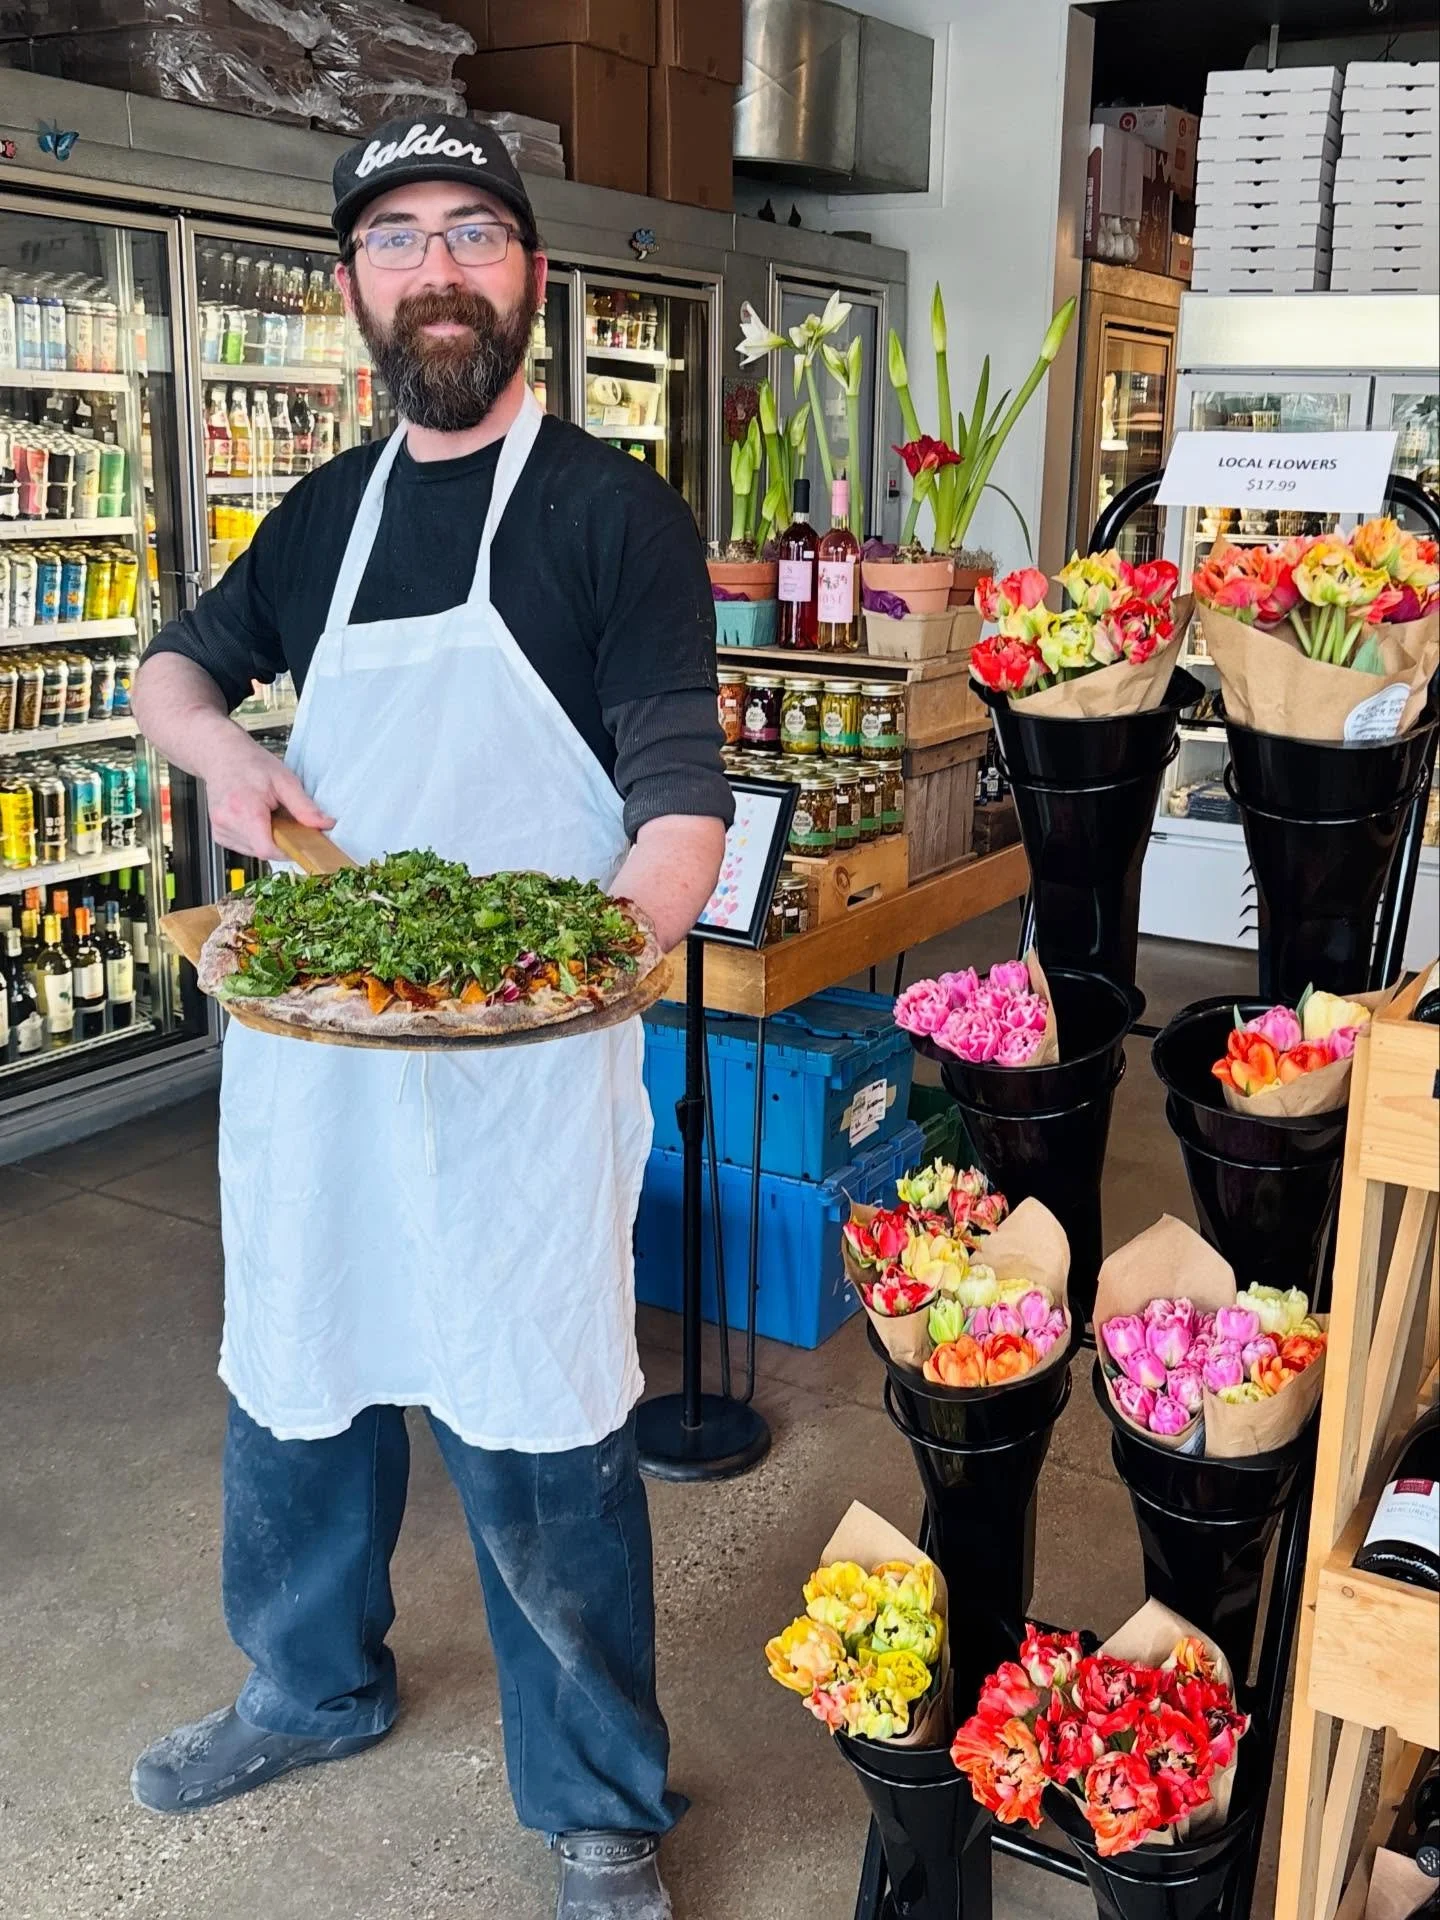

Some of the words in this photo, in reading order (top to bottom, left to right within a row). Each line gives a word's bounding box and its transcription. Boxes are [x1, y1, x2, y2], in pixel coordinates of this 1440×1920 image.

[355, 123, 488, 178] baldor
[1218, 457, 1263, 469] LOCAL
[1268, 458, 1338, 470] FLOWERS
[1247, 478, 1297, 492] $17.99
